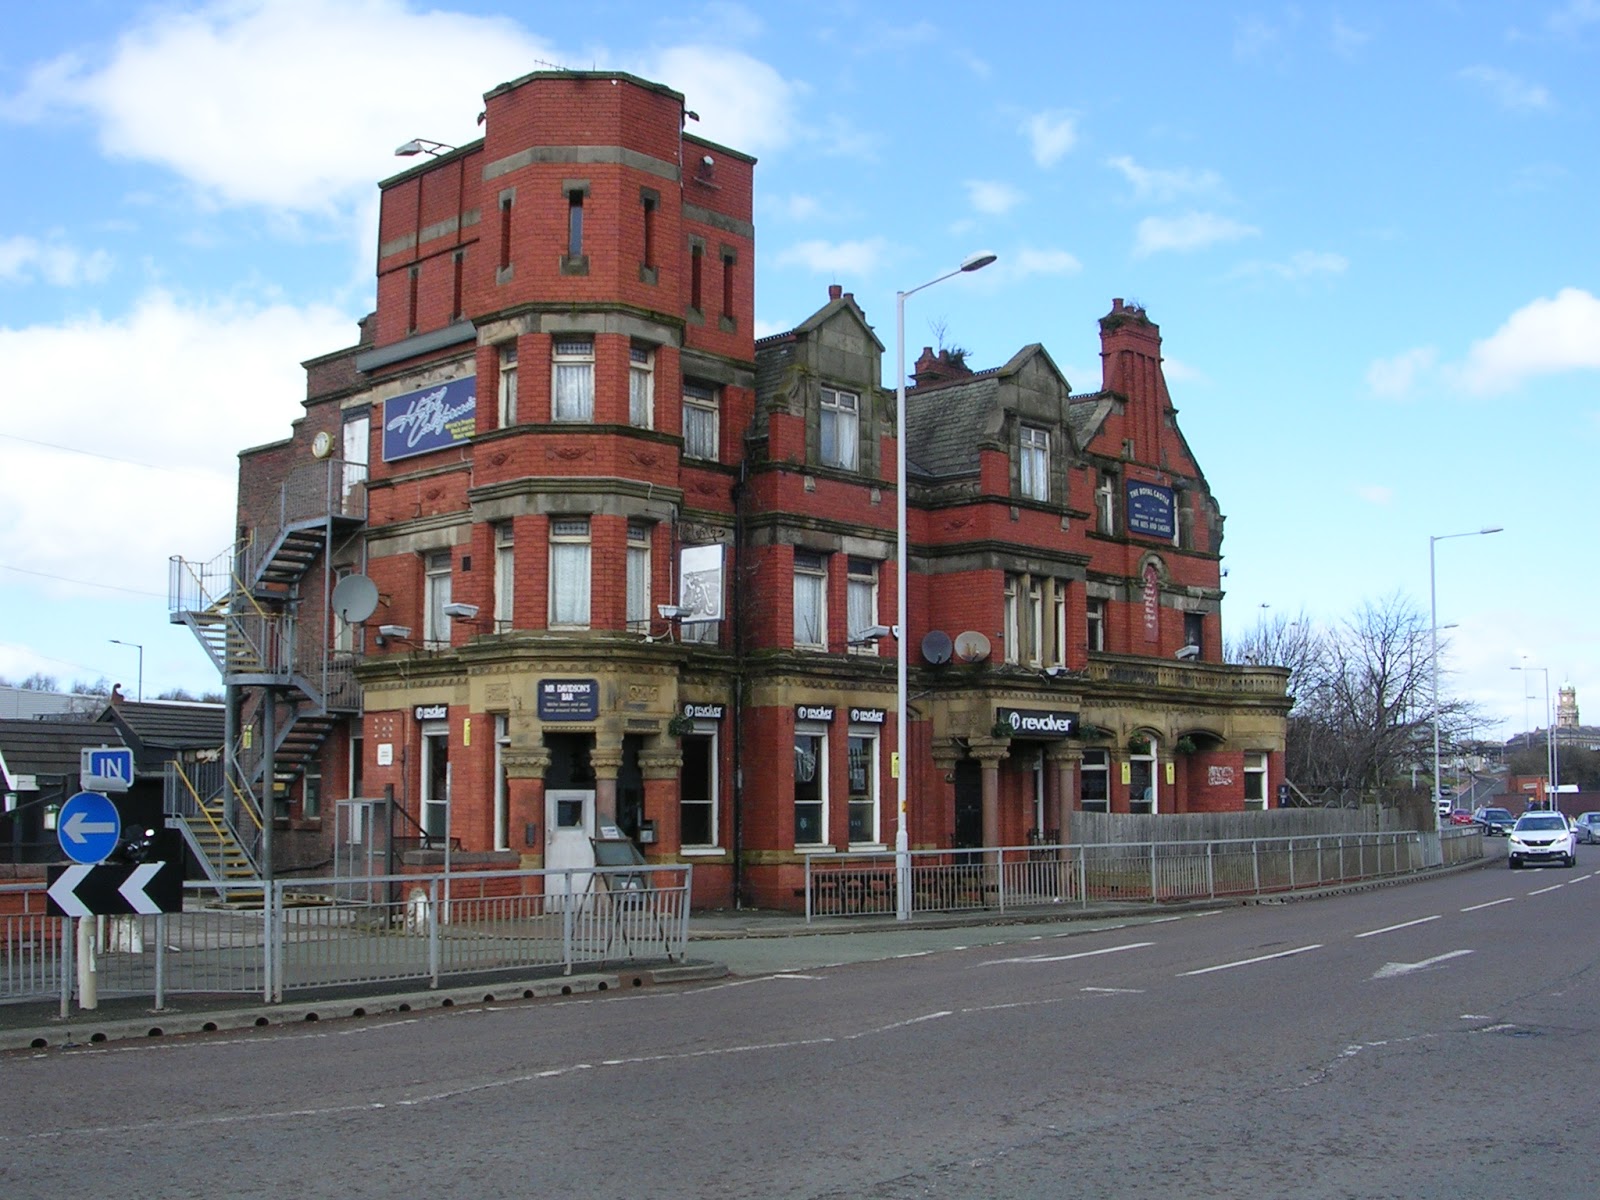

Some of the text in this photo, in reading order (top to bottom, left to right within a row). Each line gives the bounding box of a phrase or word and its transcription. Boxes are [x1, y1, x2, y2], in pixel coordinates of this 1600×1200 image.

[1130, 488, 1169, 505] THE ROYAL CASTLE
[544, 684, 591, 693] MR DAVIDSON'S
[561, 692, 574, 701] BAR
[423, 704, 447, 719] revolver
[694, 704, 722, 718] revolver
[807, 706, 833, 720] revolver
[860, 708, 884, 723] revolver
[1021, 714, 1071, 732] revolver
[100, 757, 122, 778] IN
